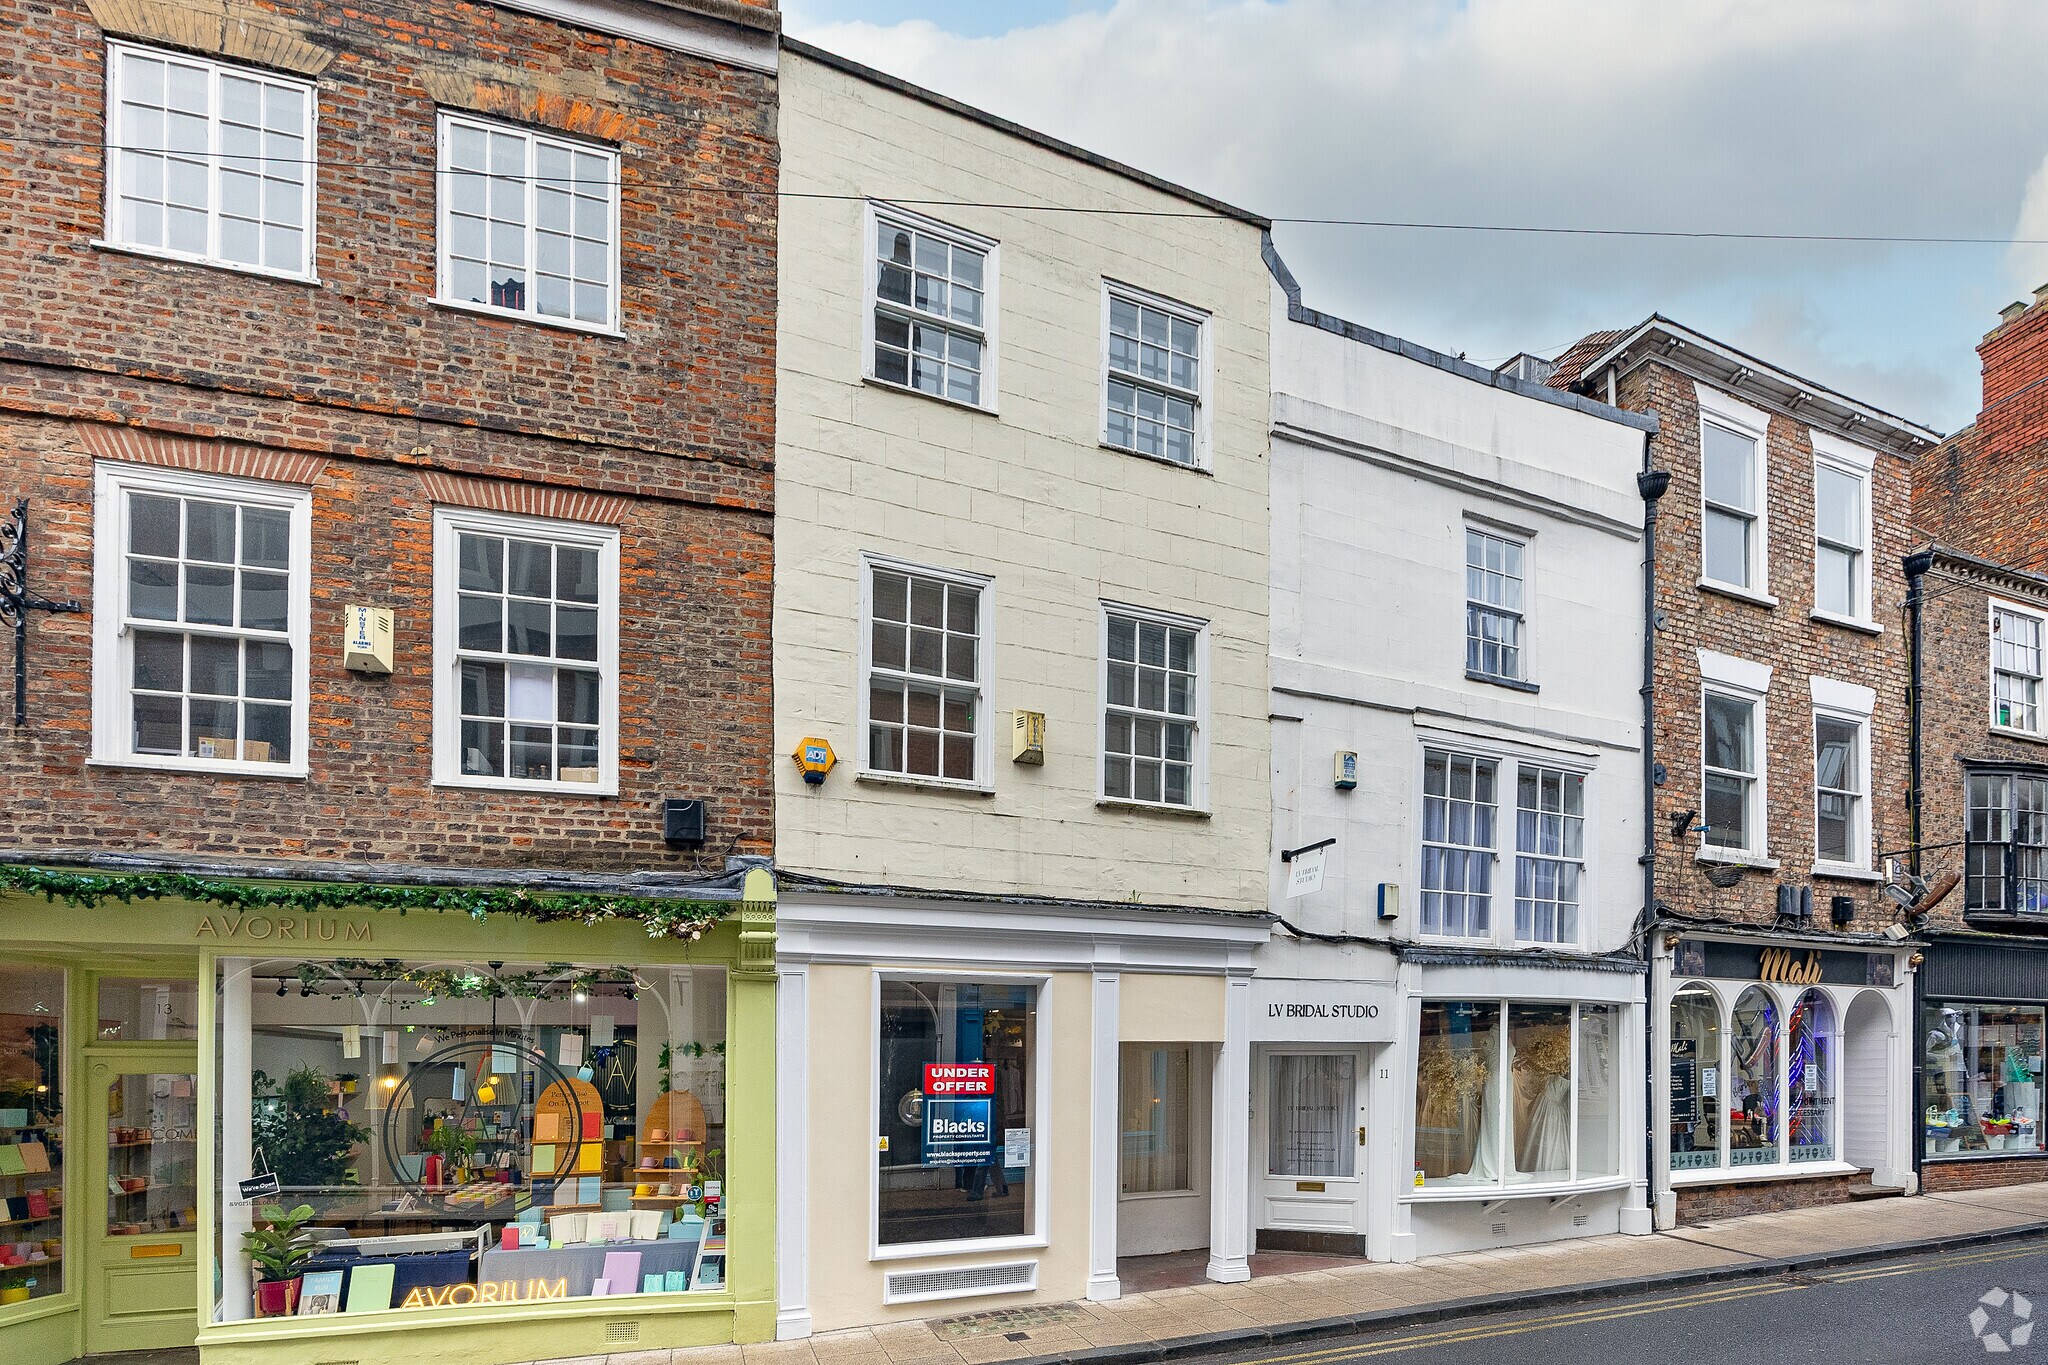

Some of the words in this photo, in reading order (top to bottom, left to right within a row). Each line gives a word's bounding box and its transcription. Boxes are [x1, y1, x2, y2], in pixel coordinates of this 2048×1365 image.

[357, 607, 367, 640] MINSTER
[806, 750, 827, 760] ADT
[194, 915, 372, 942] AVORIUM
[1760, 947, 1823, 985] Mali
[157, 1003, 172, 1015] 13
[1268, 1003, 1283, 1018] LV
[1286, 1004, 1329, 1018] BRIDAL
[1331, 1004, 1379, 1019] STUDIO
[434, 1033, 450, 1044] We
[450, 1028, 494, 1040] Personalise
[504, 1029, 535, 1044] Minutes
[931, 1067, 990, 1078] UNDER
[1379, 1069, 1389, 1079] 11
[932, 1081, 988, 1092] OFFER
[932, 1118, 986, 1134] Blacks
[926, 1150, 991, 1158] www.blacksproperty.com
[259, 1181, 276, 1189] Open
[400, 1276, 568, 1309] AVORIUM
